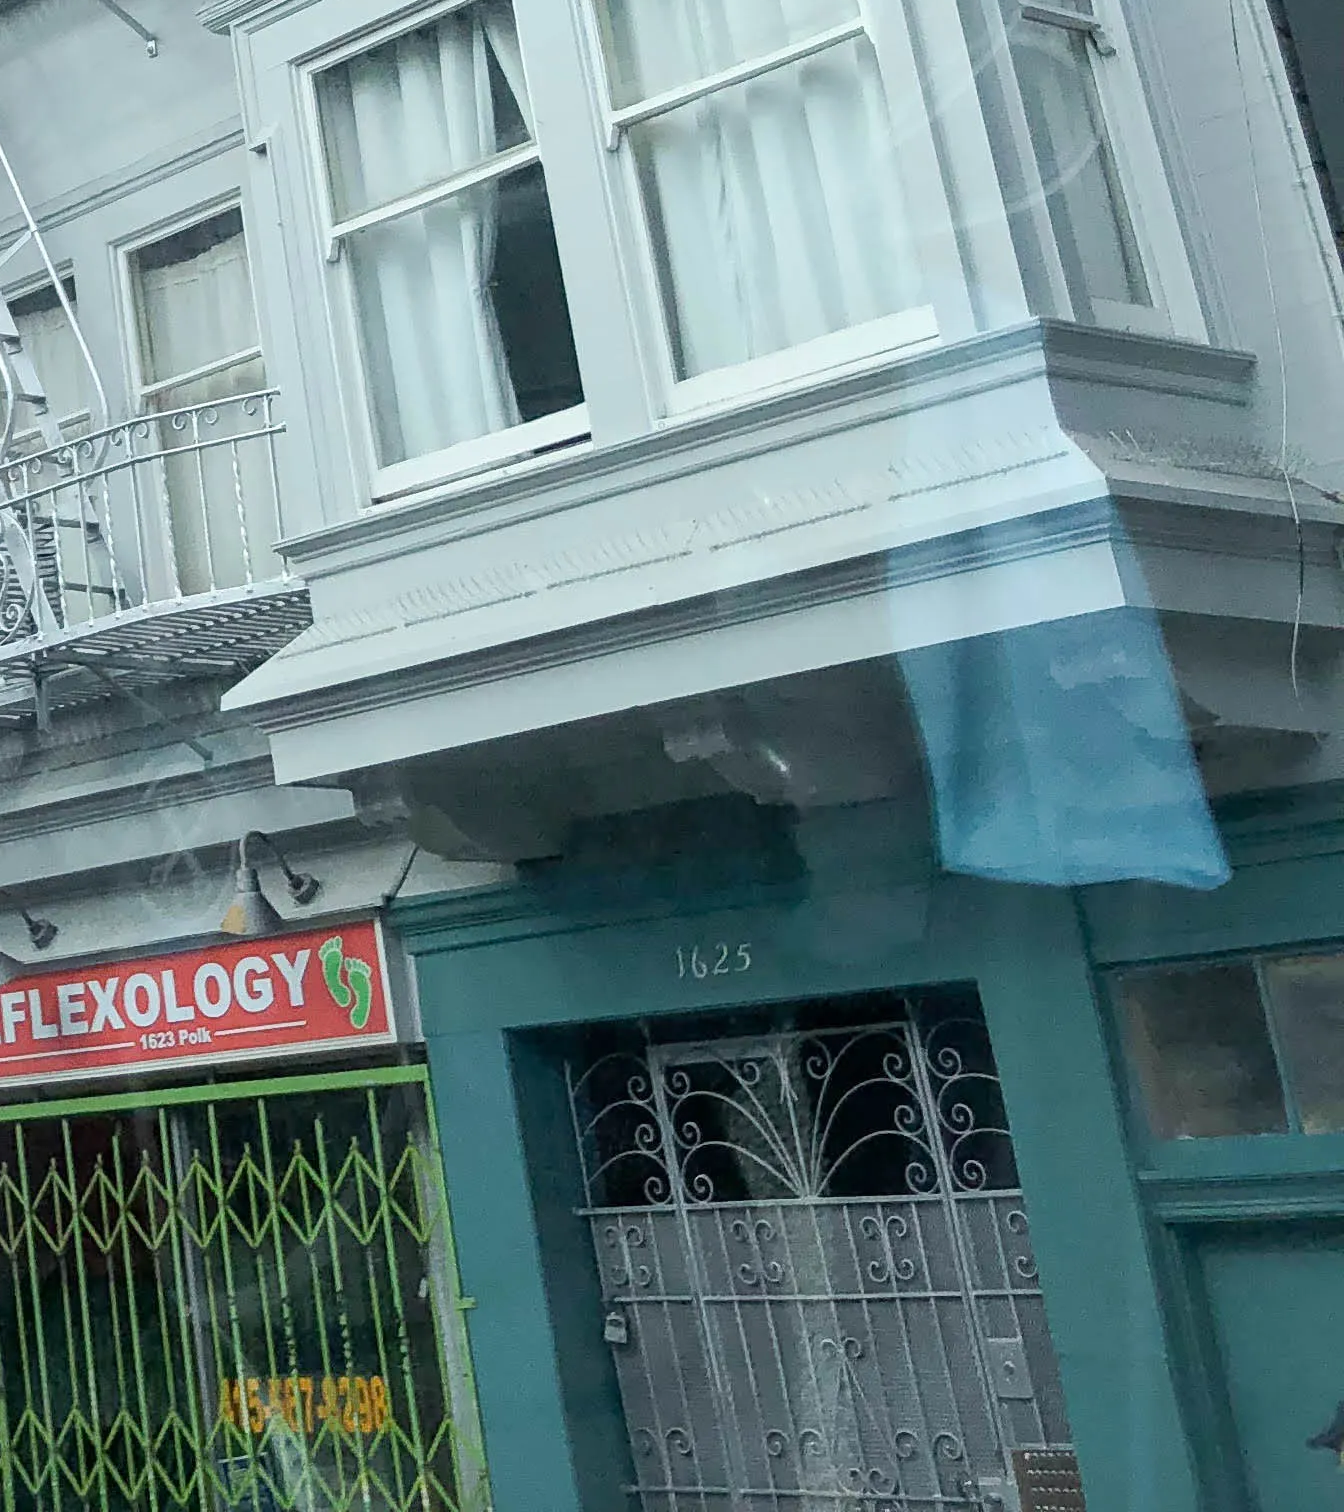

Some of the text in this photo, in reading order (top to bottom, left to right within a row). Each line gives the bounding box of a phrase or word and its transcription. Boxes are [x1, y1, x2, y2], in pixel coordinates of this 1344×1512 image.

[676, 941, 751, 978] 1625
[140, 1027, 212, 1050] 1623 Polk
